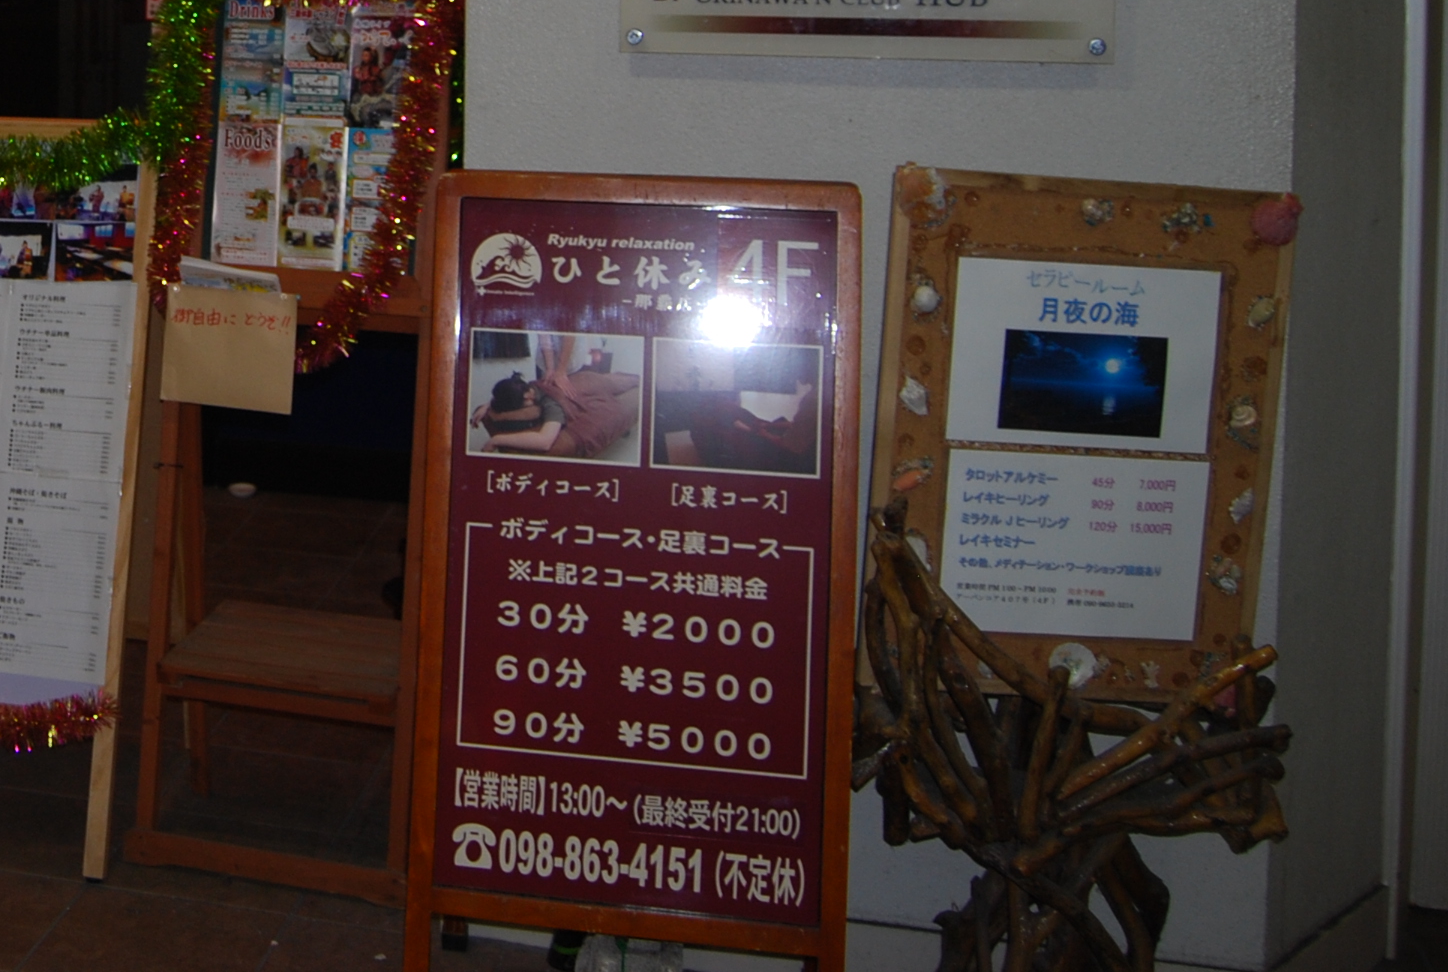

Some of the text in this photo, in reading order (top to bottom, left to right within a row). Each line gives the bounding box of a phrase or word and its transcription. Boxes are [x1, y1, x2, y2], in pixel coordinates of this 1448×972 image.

[229, 0, 276, 19] Drinks
[224, 128, 272, 151] Foods
[548, 233, 695, 252] Ryukyu relaxation
[551, 256, 712, 290] ひと休み
[730, 239, 819, 308] 4F
[1027, 269, 1146, 296] セラピールーム
[1039, 297, 1140, 327] 月夜の海
[965, 468, 1058, 485] タロットアルケミー
[1092, 477, 1115, 489] 45分
[963, 491, 1049, 507] レイキヒーリング
[500, 518, 781, 559] ボディコース・足裏コース
[959, 534, 1036, 549] レイキセミナー
[497, 601, 588, 634] 30分
[495, 656, 586, 689] 60分
[493, 709, 584, 744] 90分
[499, 829, 702, 894] 098-863-4151
